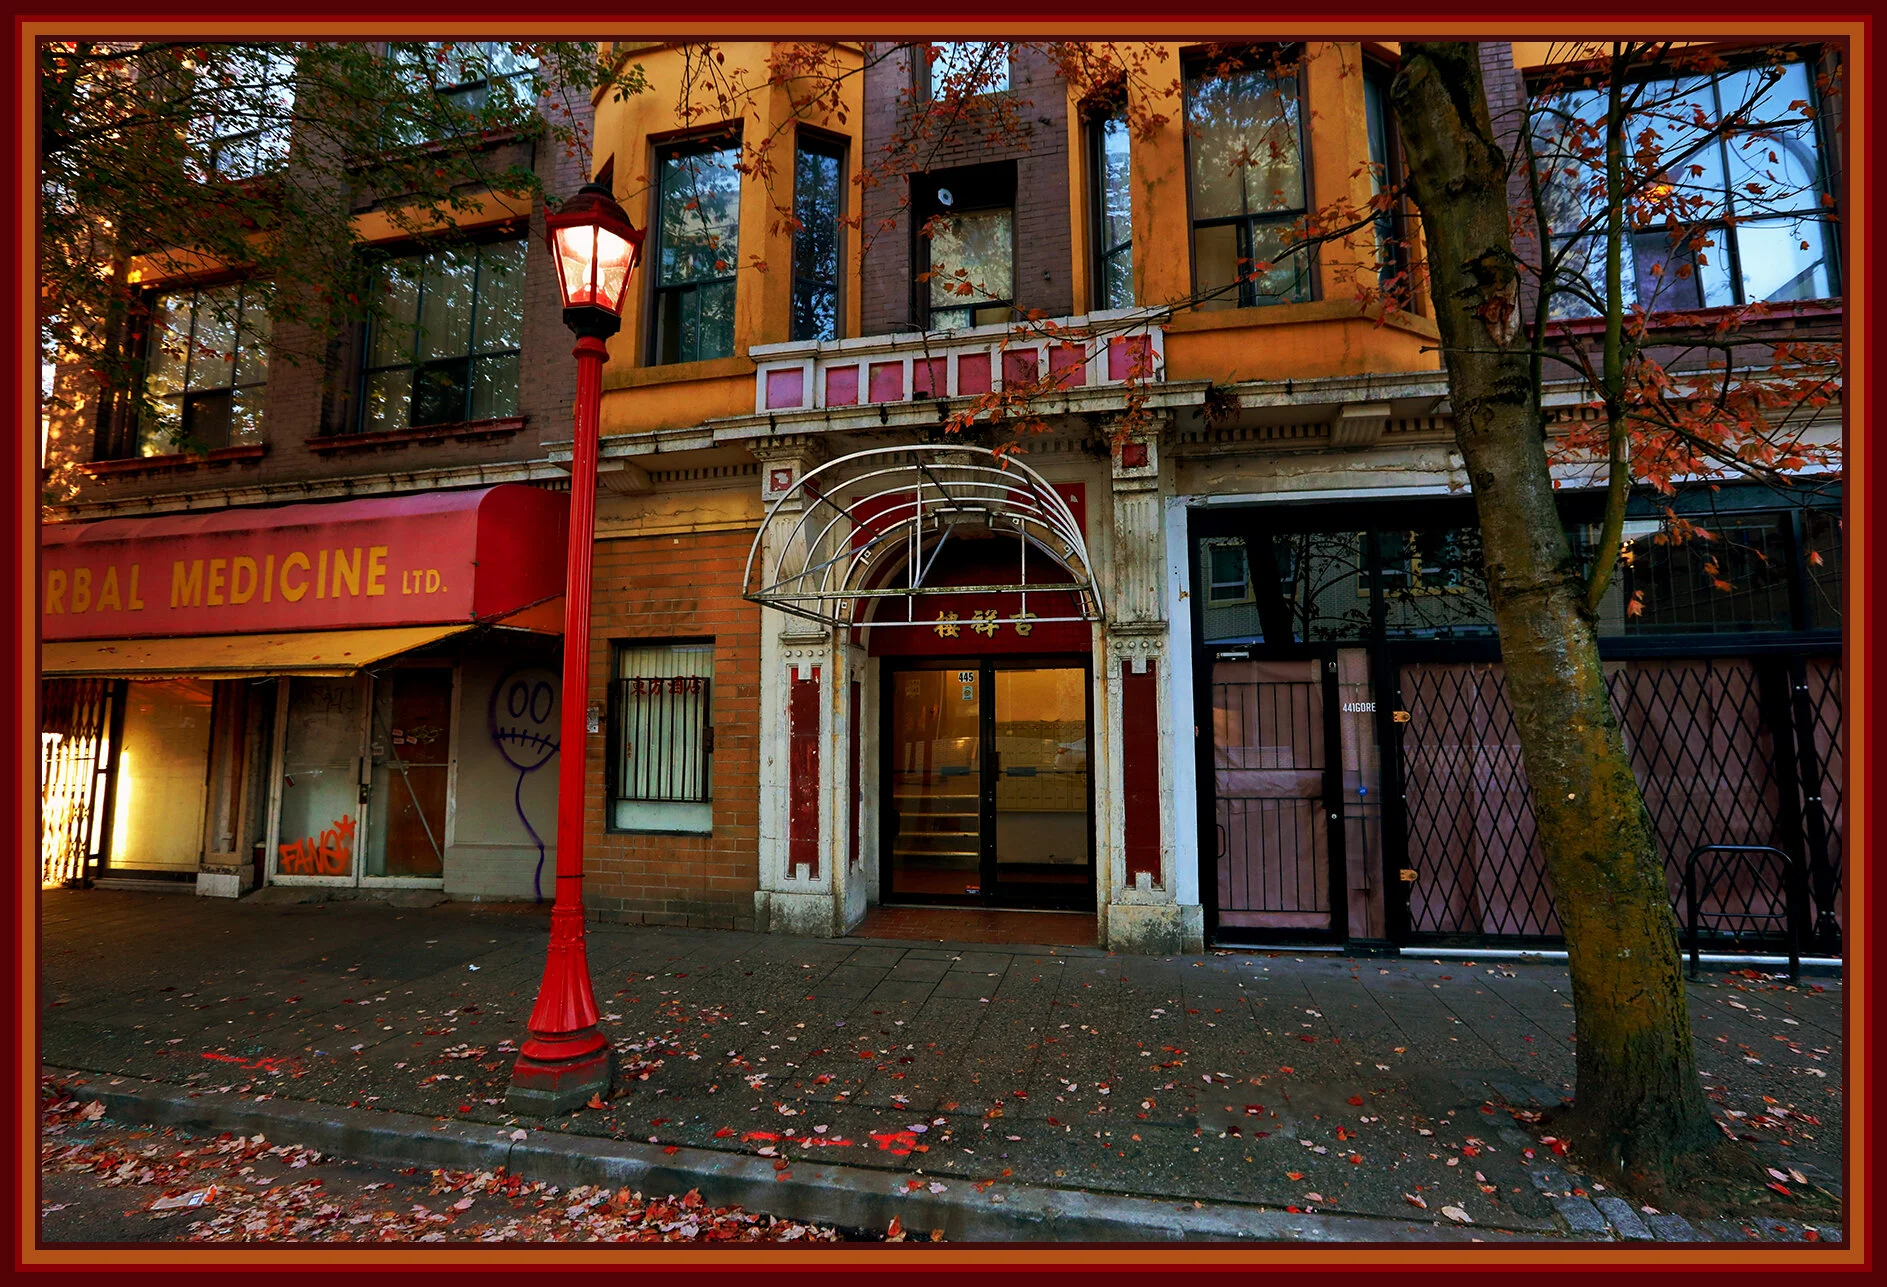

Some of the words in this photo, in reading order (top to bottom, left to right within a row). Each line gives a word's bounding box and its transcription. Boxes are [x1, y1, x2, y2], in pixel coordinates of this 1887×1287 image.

[45, 564, 144, 614] RBAL
[170, 545, 388, 609] MEDICINE
[402, 568, 448, 595] LTD.
[958, 671, 974, 683] 445
